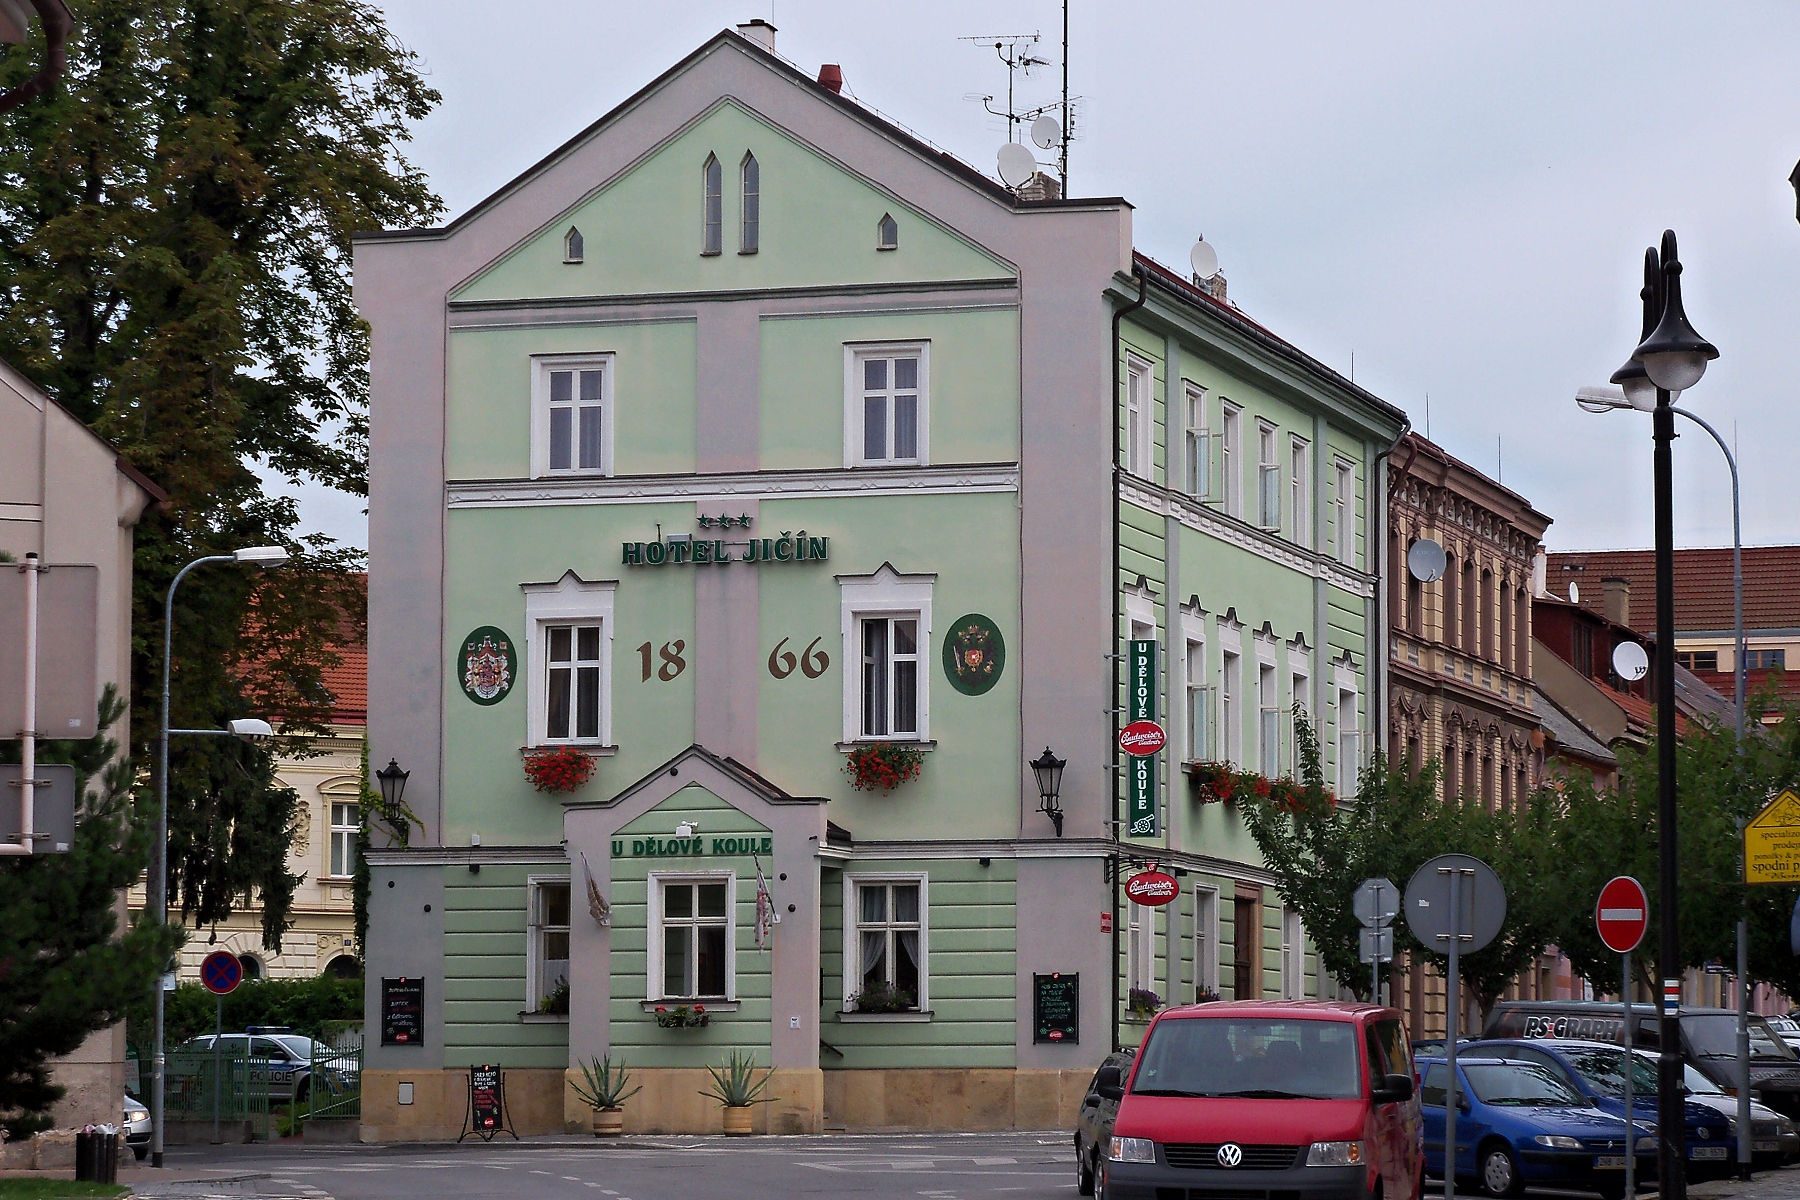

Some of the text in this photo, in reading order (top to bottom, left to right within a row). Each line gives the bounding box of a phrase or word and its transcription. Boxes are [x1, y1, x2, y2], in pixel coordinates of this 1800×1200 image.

[622, 530, 830, 565] HOTEL JIČÍN
[636, 636, 830, 683] 18 66
[1137, 643, 1148, 810] U DĚLOVÉ KOULE
[611, 836, 772, 856] U DĚLOVÉ KOULE
[1523, 1017, 1624, 1041] PS-GRAPH
